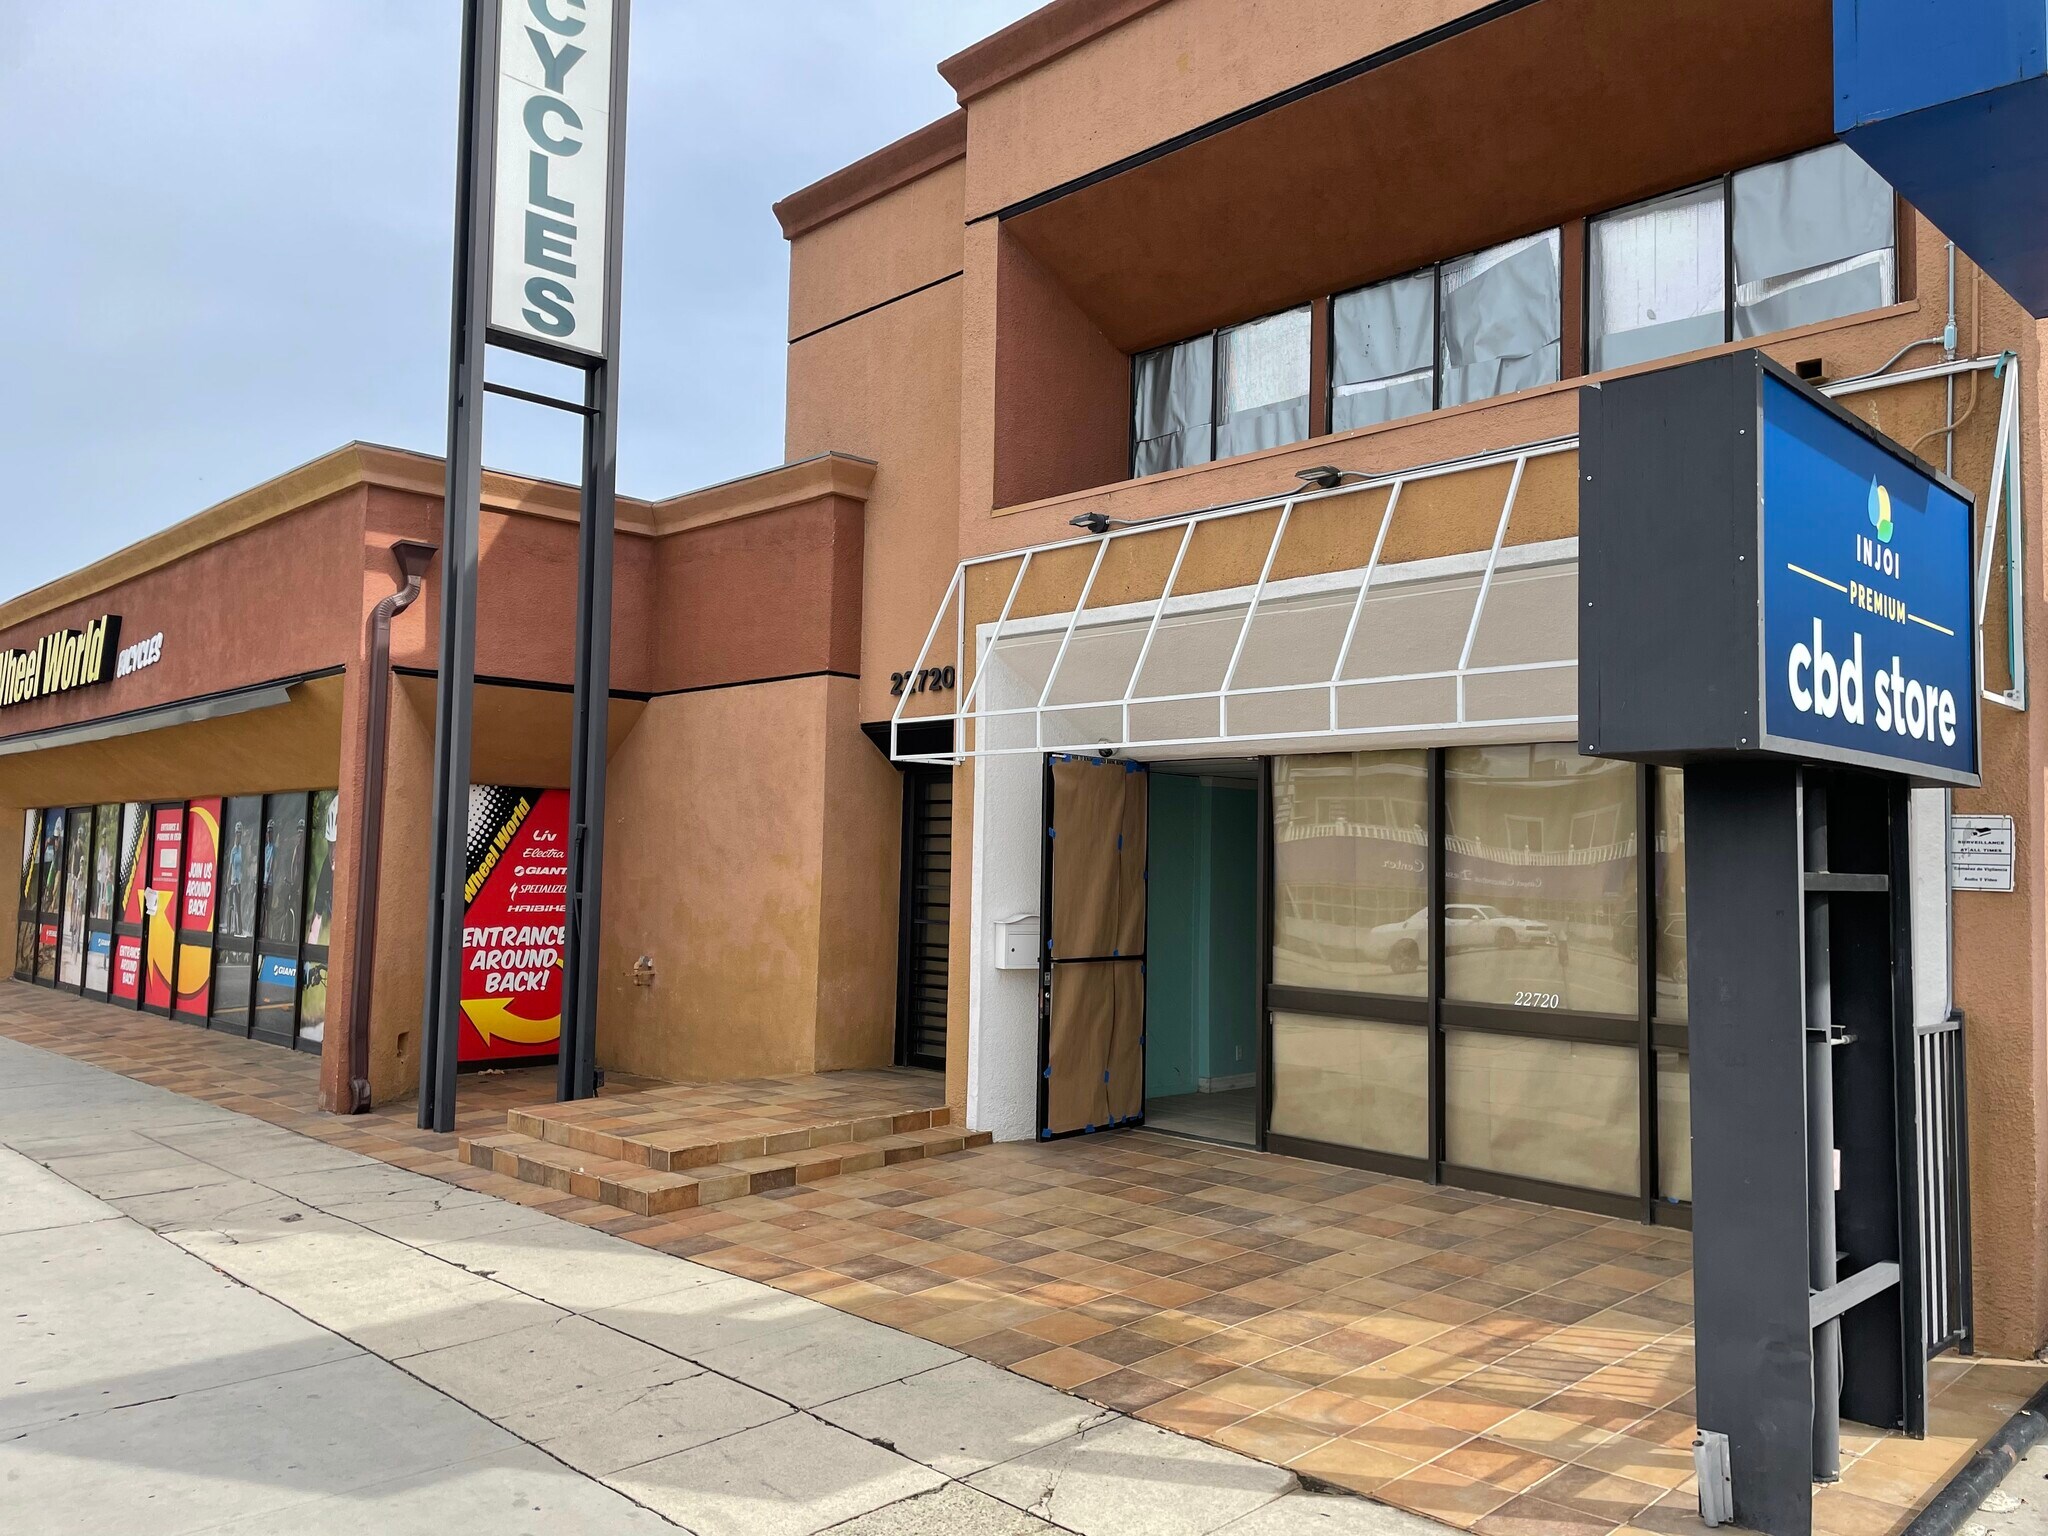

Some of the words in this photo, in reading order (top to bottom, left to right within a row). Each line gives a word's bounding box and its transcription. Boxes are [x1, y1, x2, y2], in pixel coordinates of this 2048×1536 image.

[1856, 534, 1900, 580] INJOI
[1849, 579, 1906, 625] PREMIUM
[42, 614, 108, 695] World
[116, 631, 164, 679] BICYCLES
[890, 665, 955, 696] 22720
[1788, 616, 1865, 726] cbd
[1874, 655, 1957, 747] store
[533, 829, 557, 842] Liv
[464, 845, 500, 904] Wheel
[493, 796, 531, 851] World
[522, 848, 565, 859] Electra
[188, 862, 203, 878] JOIN
[203, 862, 213, 879] US
[526, 867, 568, 875] GIANT
[186, 880, 212, 898] AROUND
[188, 898, 208, 917] BACK!
[470, 948, 558, 971] AROUND
[485, 970, 550, 993] BACK!
[1514, 991, 1559, 1009] 22720
